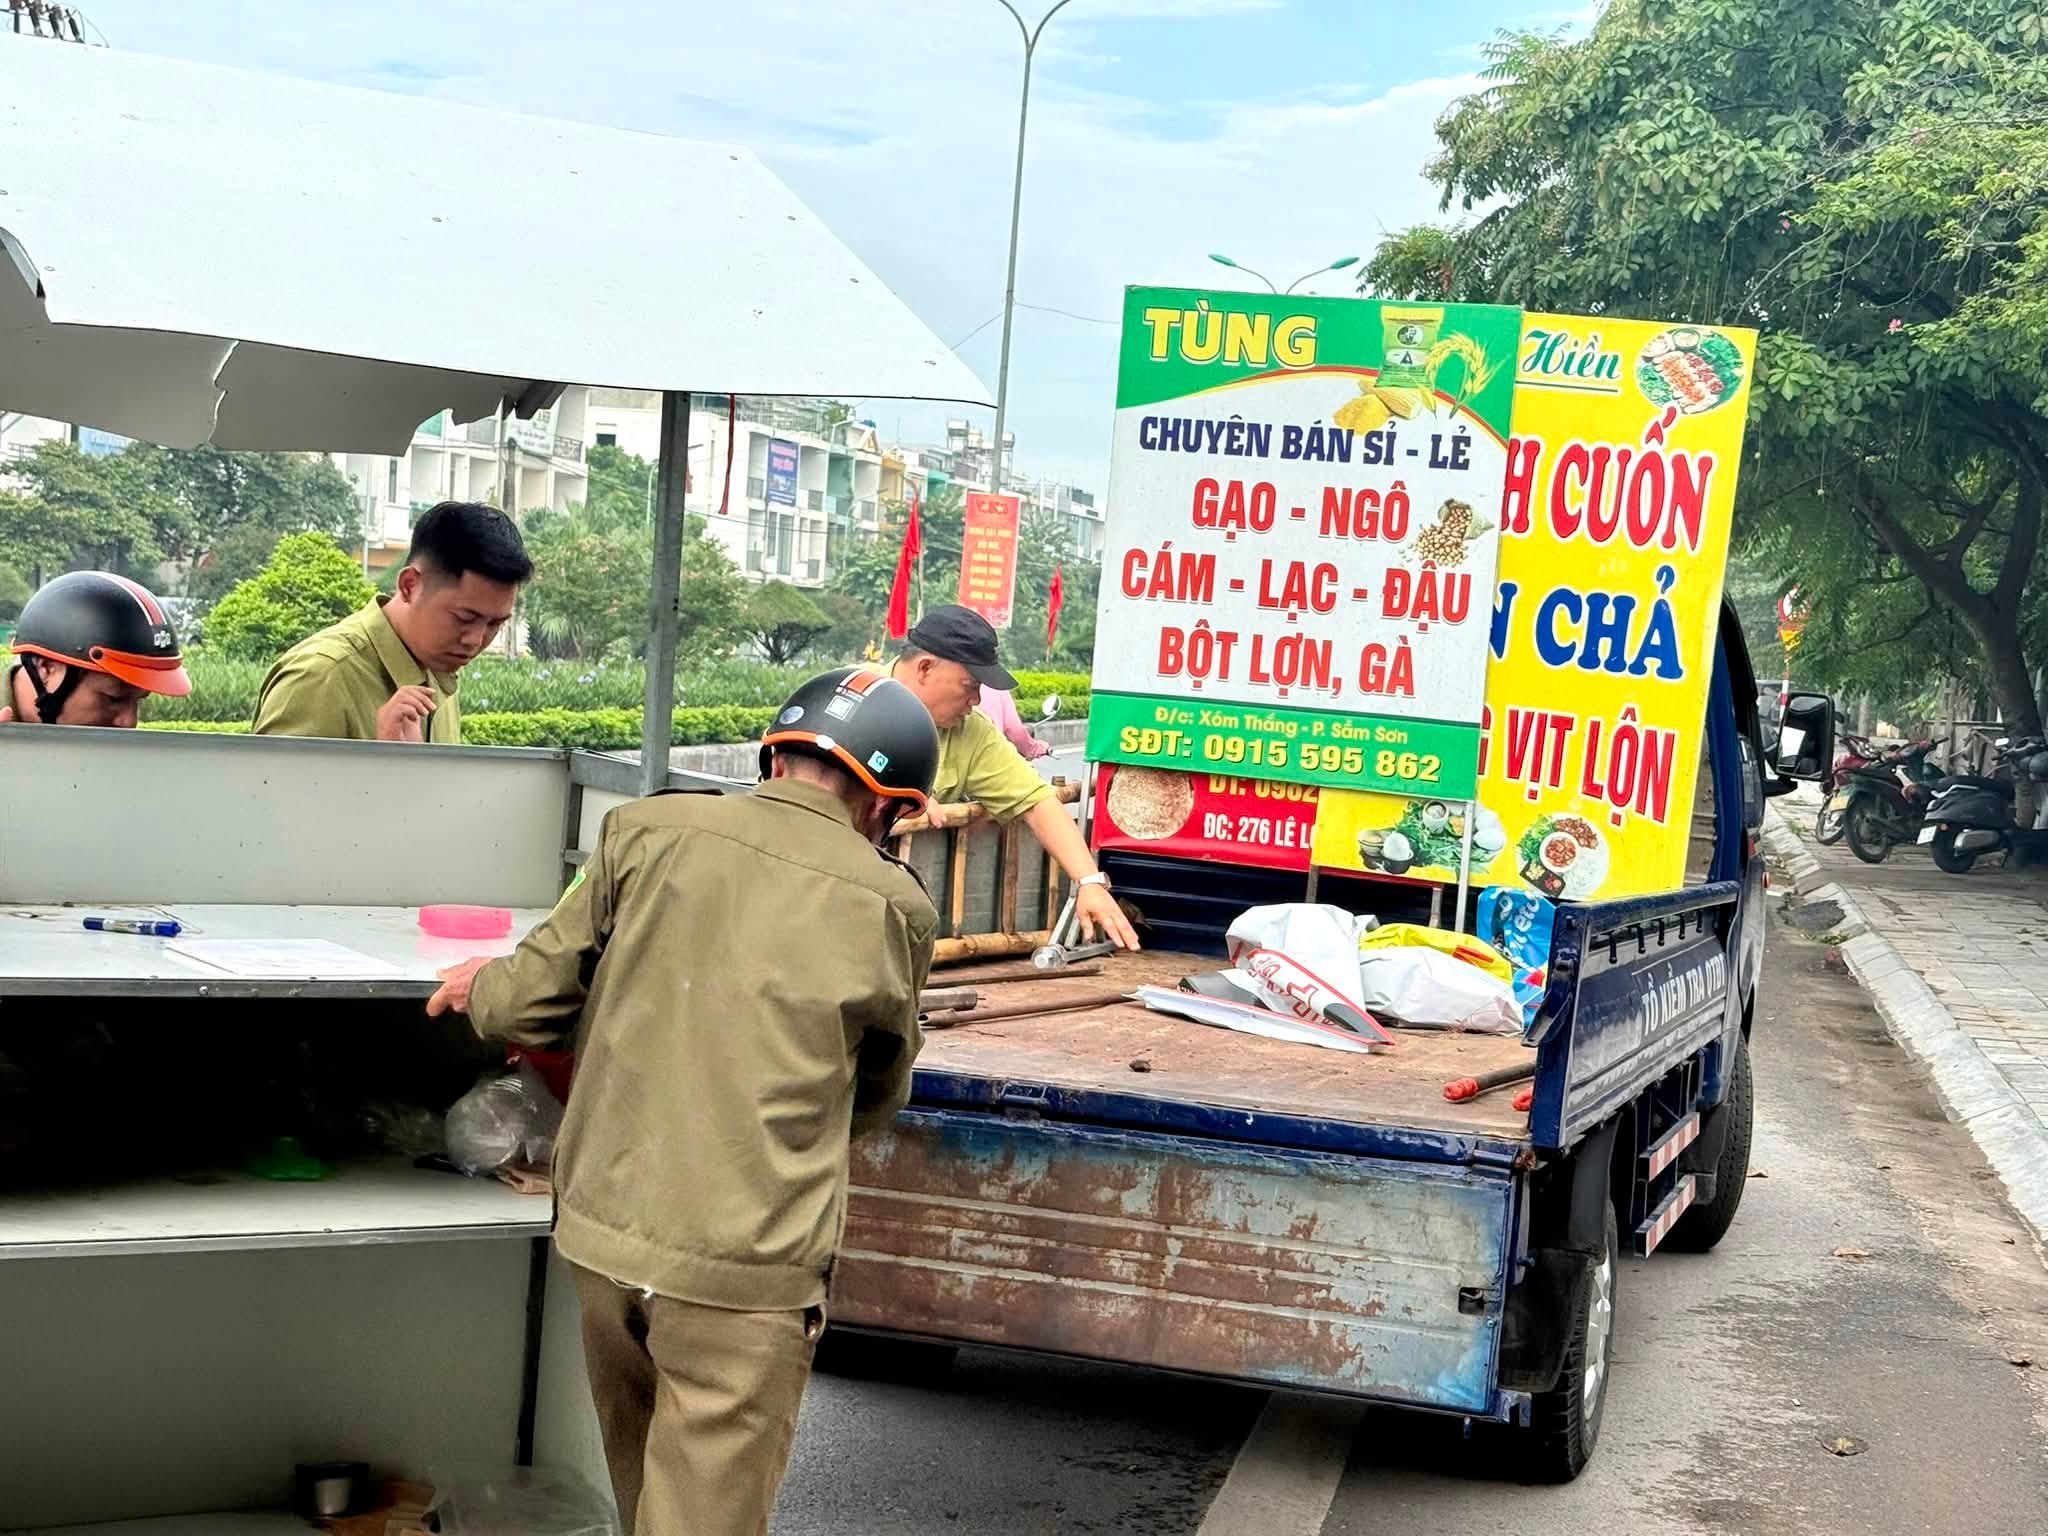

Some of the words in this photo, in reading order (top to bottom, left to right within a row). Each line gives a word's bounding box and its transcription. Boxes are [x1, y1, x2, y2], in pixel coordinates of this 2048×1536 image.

[1144, 299, 1318, 370] TÙNG
[1522, 329, 1620, 380] Hiền
[1140, 414, 1272, 458] CHUYÊN
[1281, 420, 1354, 463] BÁN
[1364, 420, 1396, 466] SỈ
[1428, 425, 1471, 470] LẺ
[1192, 478, 1276, 541] GẠO
[1319, 480, 1411, 542] NGÔ
[1551, 406, 1712, 552] CUỐN
[1121, 541, 1216, 605] CÁM
[1257, 558, 1339, 622] LẠC
[1382, 560, 1471, 633] ĐẬU
[1536, 565, 1683, 679] CHẢ
[1157, 619, 1239, 690] BỘT
[1249, 632, 1342, 698] LỢN,
[1358, 635, 1415, 698] GÀ
[1120, 726, 1193, 758] SĐT:
[1204, 735, 1288, 768] 0915
[1300, 744, 1363, 775] 595
[1375, 752, 1441, 783] 862
[1155, 707, 1194, 724] Đ/c:
[1199, 711, 1239, 730] Xóm
[1244, 714, 1297, 738] Thắng
[1313, 722, 1327, 736] P.
[1375, 726, 1408, 744] Sơn
[1507, 709, 1574, 800] VỊT
[1582, 707, 1675, 826] LỘN
[1237, 816, 1270, 845] 276
[1274, 815, 1296, 848] LÊ
[1641, 972, 1659, 1037] TỔ
[1660, 962, 1686, 1026] KIỂM
[1686, 965, 1705, 1007] TRA
